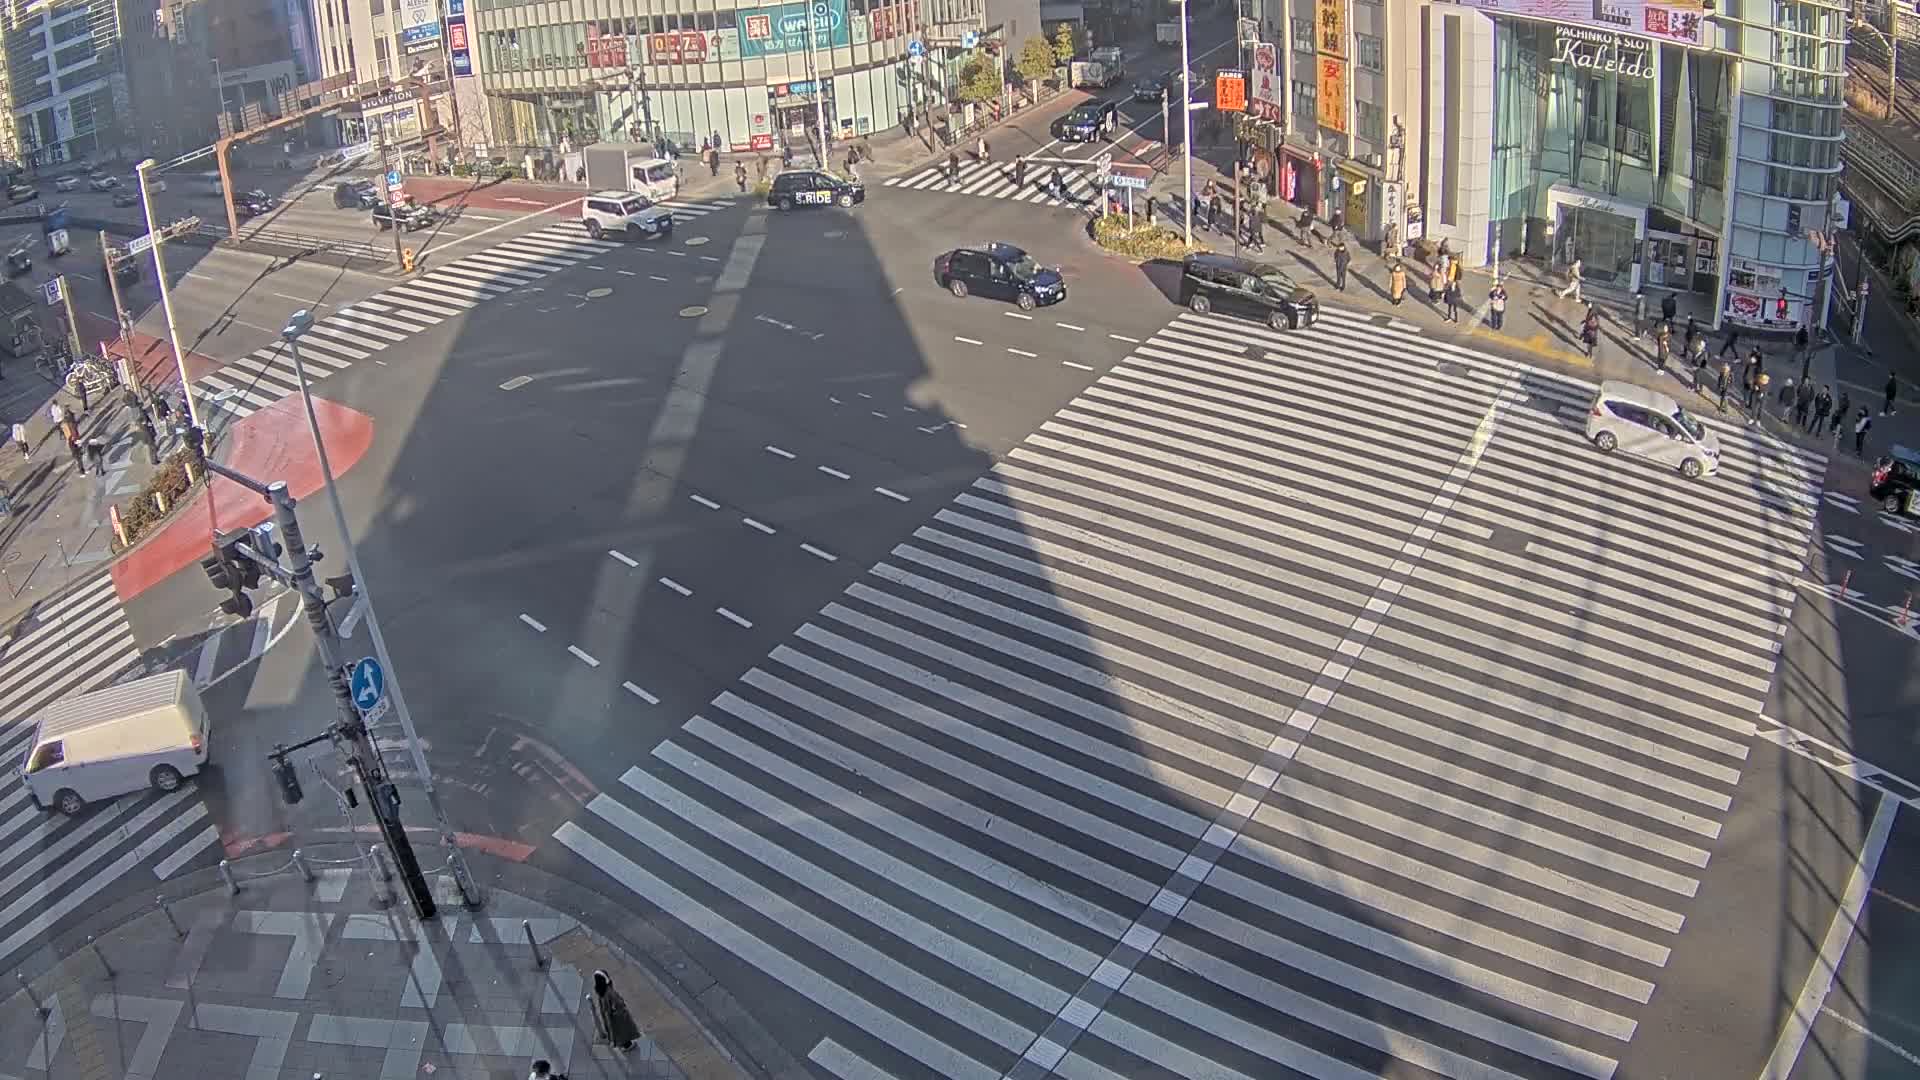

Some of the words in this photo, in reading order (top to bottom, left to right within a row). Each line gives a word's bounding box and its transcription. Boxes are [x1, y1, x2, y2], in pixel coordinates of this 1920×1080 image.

[1556, 26, 1612, 44] PACHINKO
[1550, 38, 1655, 79] Kaleido
[796, 194, 832, 205] S.RIDE
